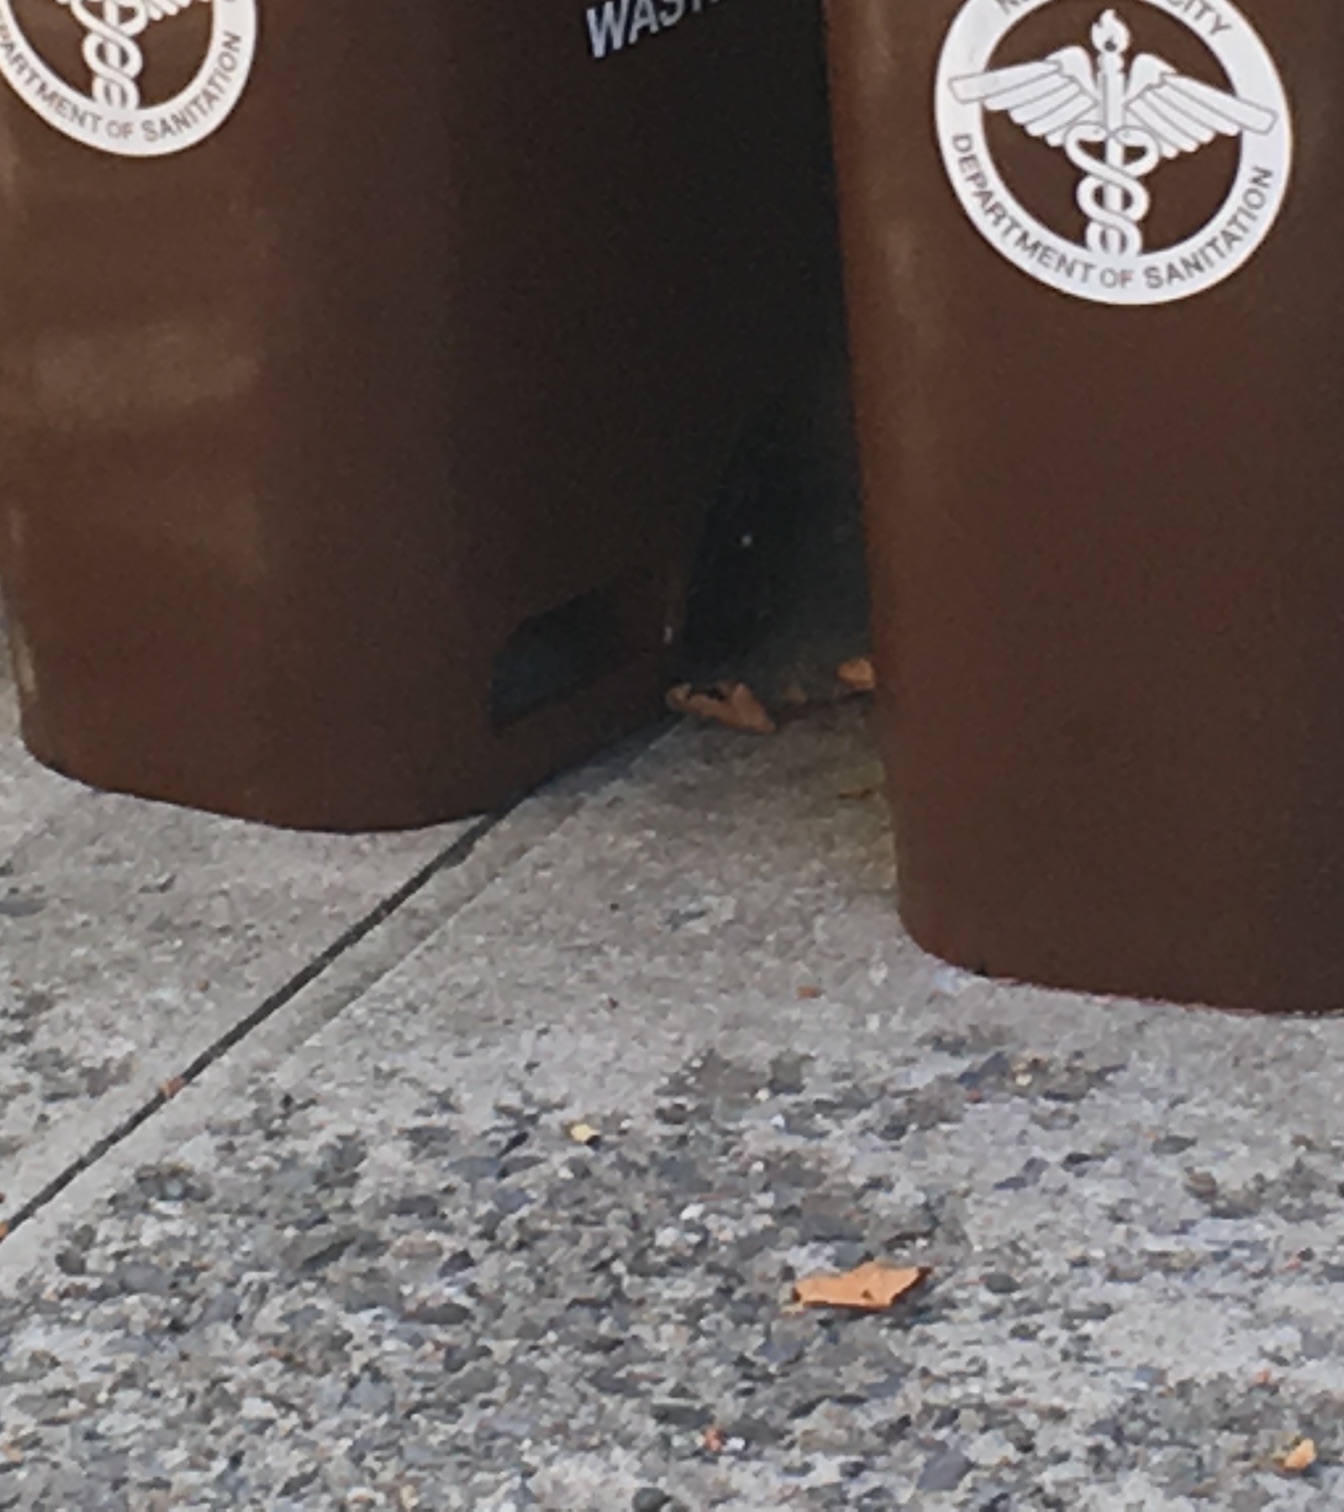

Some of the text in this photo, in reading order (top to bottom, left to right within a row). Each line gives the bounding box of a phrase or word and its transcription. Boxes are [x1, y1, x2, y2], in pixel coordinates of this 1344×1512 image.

[105, 117, 136, 141] OF
[142, 30, 243, 143] SANITATION
[952, 133, 1275, 289] DEPARTMENT OF SANITATION
